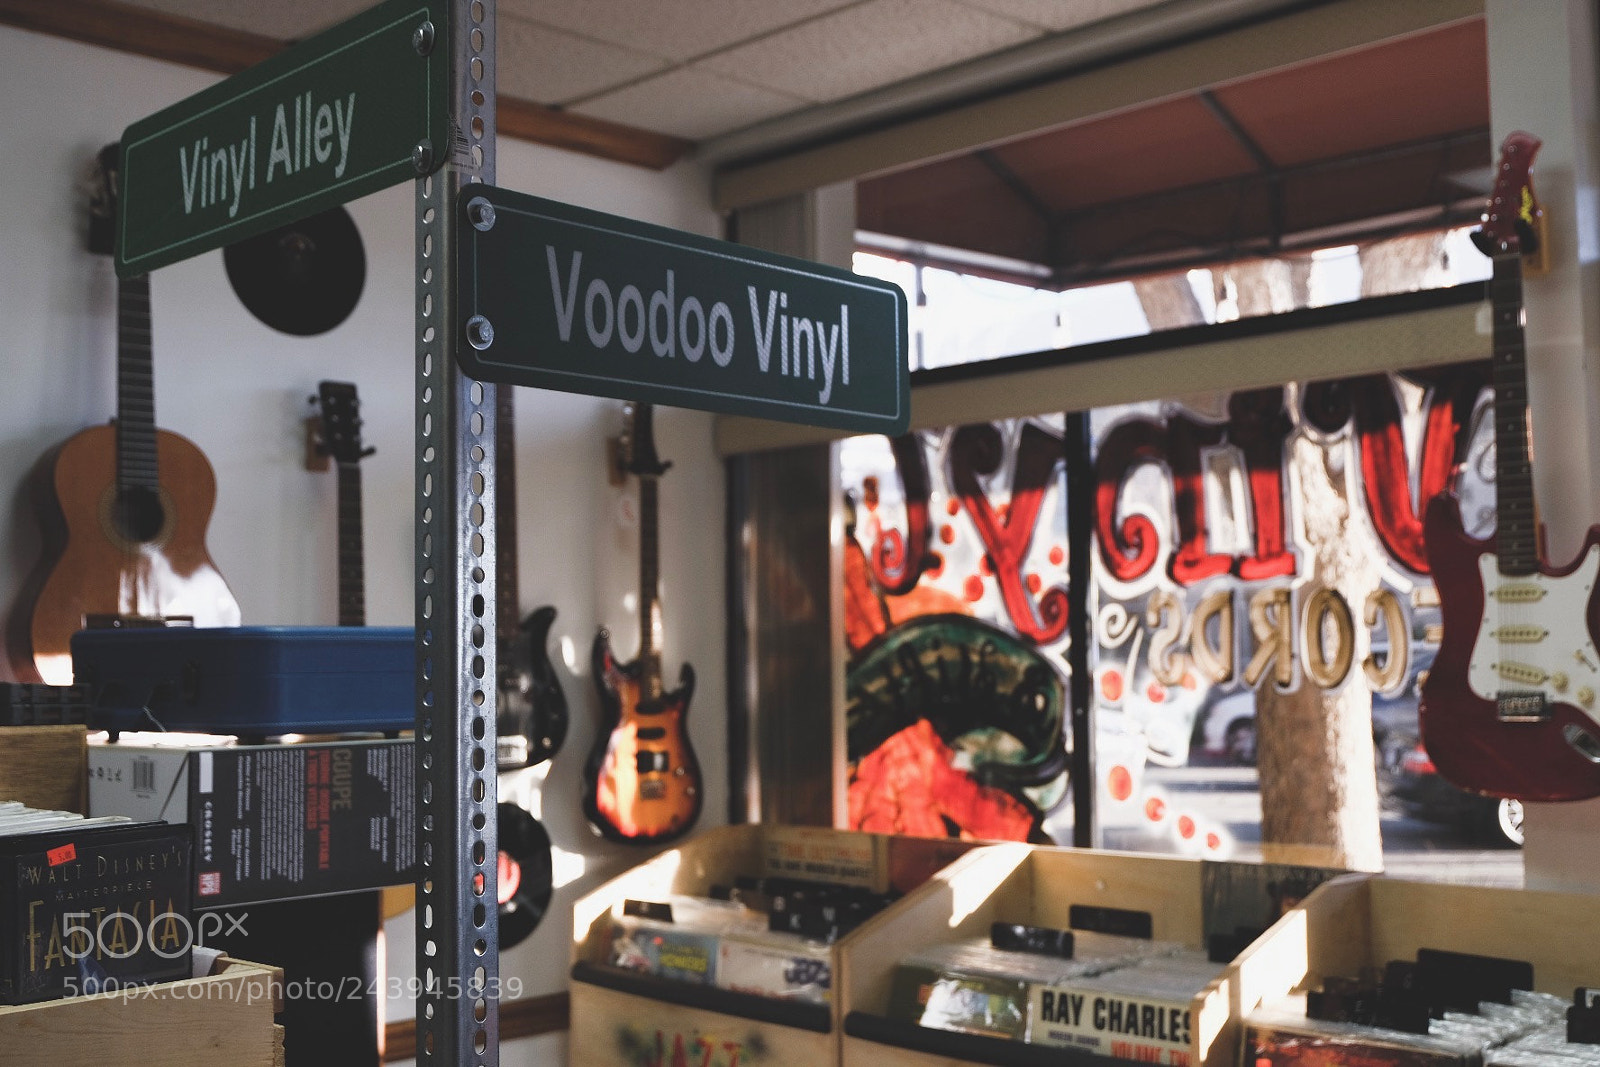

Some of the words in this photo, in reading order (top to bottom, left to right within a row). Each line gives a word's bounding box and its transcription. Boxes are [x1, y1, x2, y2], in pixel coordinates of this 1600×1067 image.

[179, 116, 257, 218] Vinyl
[266, 90, 355, 179] Alley
[545, 244, 735, 368] Voodoo
[747, 285, 849, 405] Vinyl
[332, 748, 352, 810] COUPE
[204, 801, 213, 862] CROSLEY
[28, 864, 82, 885] WALT
[97, 846, 182, 876] DISNEY'S
[26, 898, 180, 972] FANTASIA
[1041, 989, 1084, 1026] RAY
[1092, 997, 1191, 1044] CHARLES
